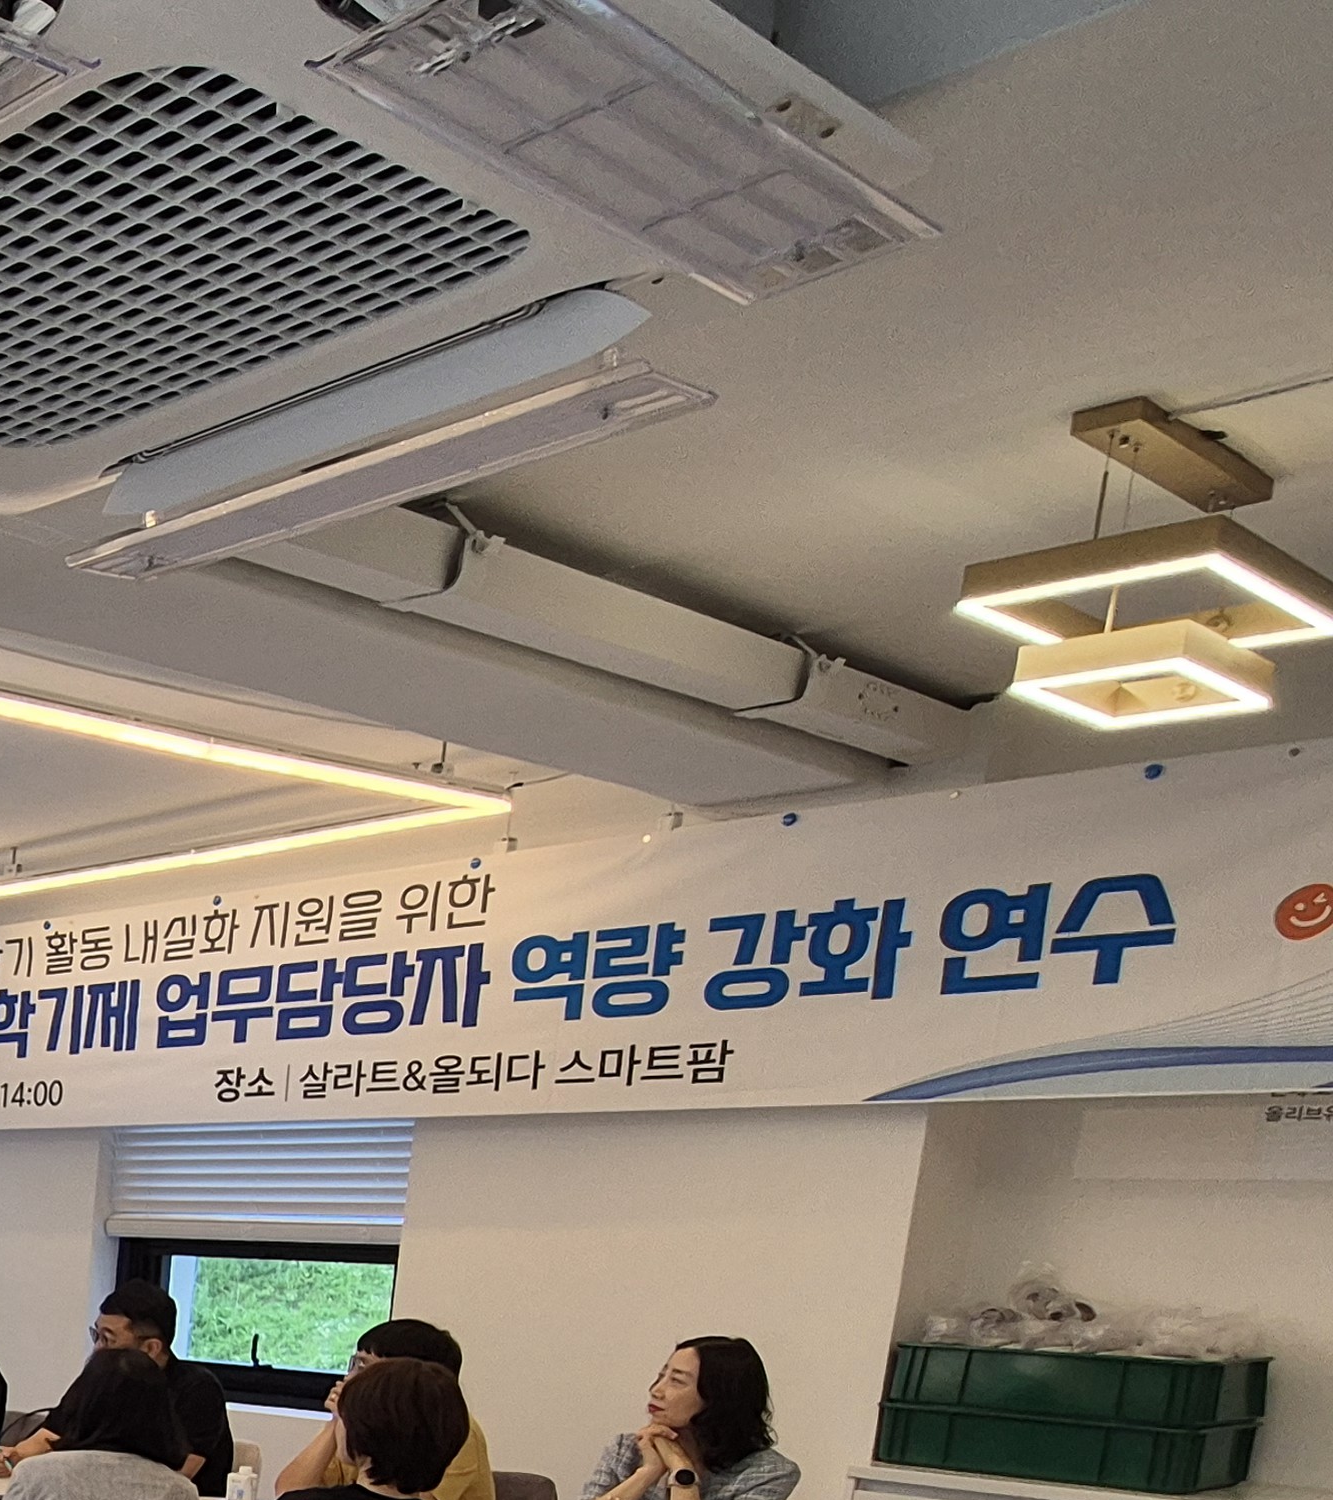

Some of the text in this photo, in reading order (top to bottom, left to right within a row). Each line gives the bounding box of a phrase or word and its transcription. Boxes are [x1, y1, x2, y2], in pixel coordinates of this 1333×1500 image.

[44, 925, 114, 977] 활동
[123, 908, 241, 964] 내실화
[250, 888, 382, 948] 지원을
[395, 873, 496, 935] 위한
[155, 943, 491, 1049] 업무담당자
[510, 922, 686, 1021] 역량
[702, 897, 913, 1012] 강화
[938, 873, 1176, 996] 연수
[0, 1080, 64, 1109] 14:00
[214, 1040, 734, 1103] 장소 살라트&올되다 스마트팜
